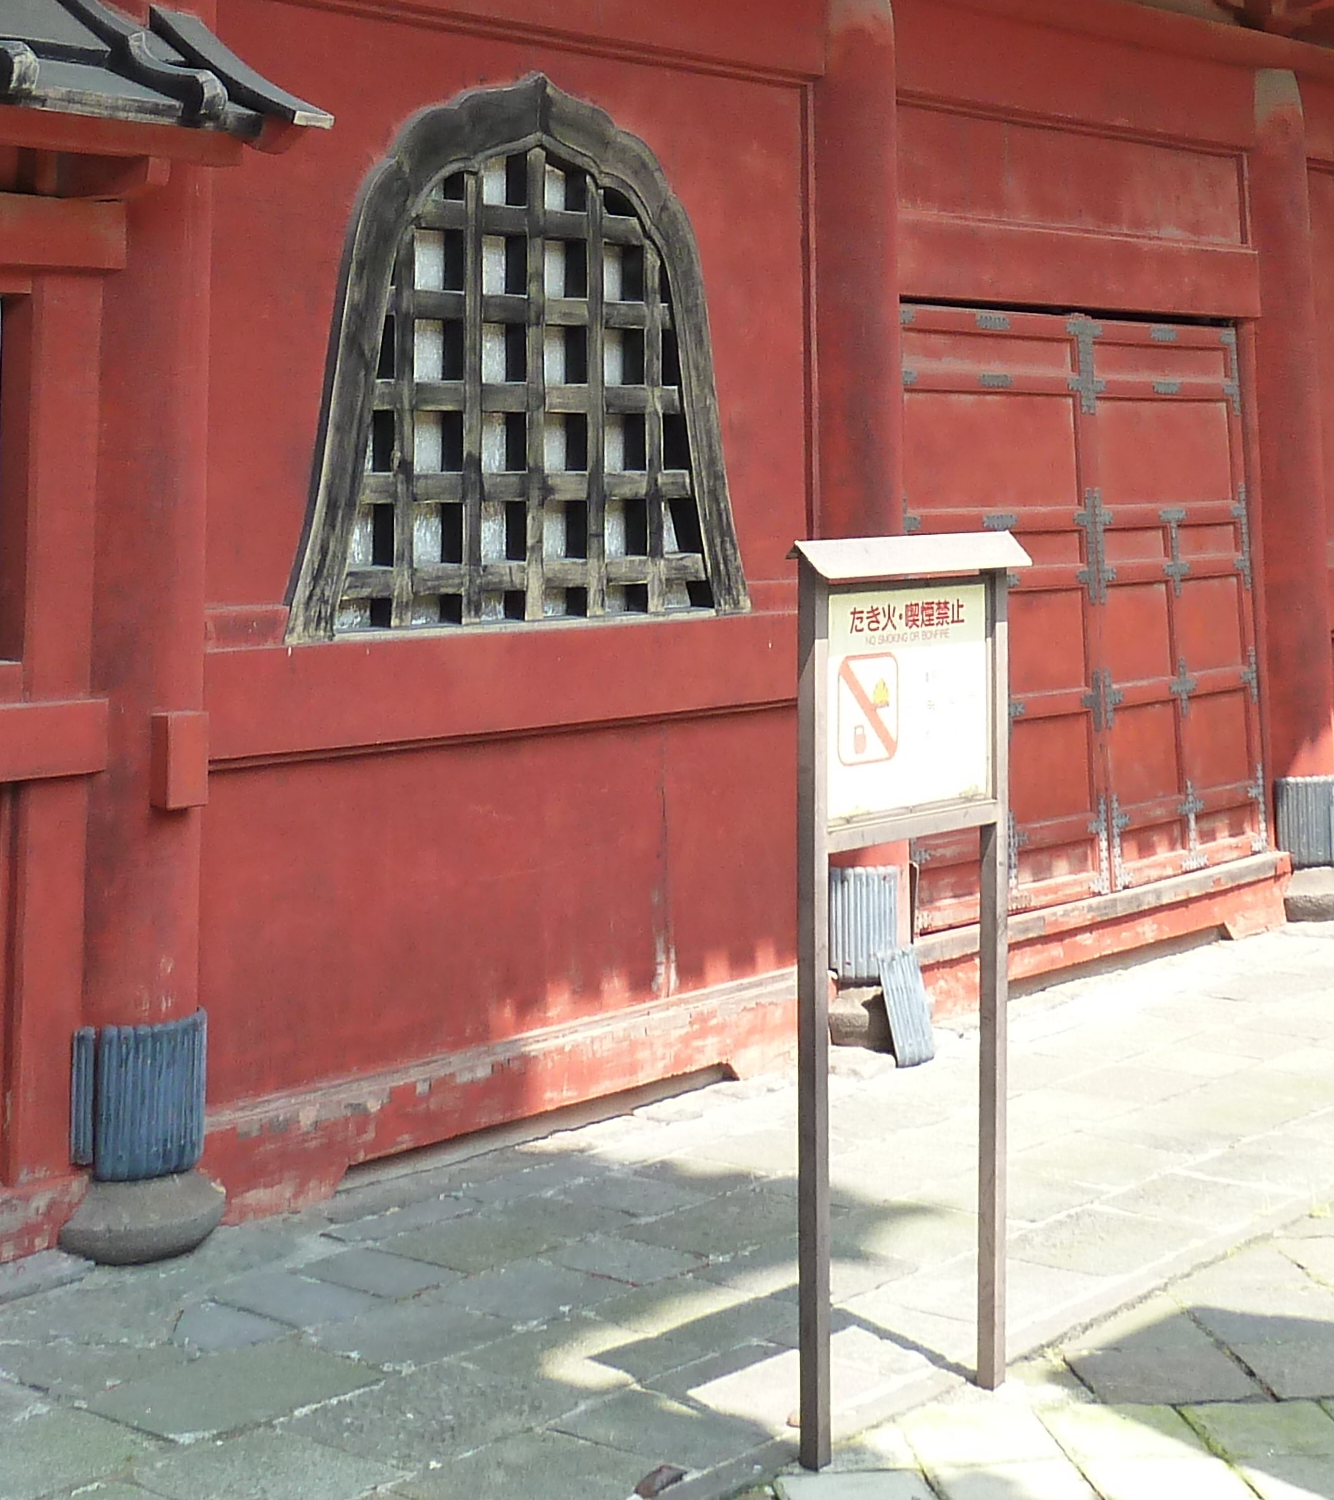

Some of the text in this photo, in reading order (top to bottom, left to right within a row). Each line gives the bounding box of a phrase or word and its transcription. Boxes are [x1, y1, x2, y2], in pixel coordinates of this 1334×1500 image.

[850, 598, 965, 634] たき火・喫煙禁止
